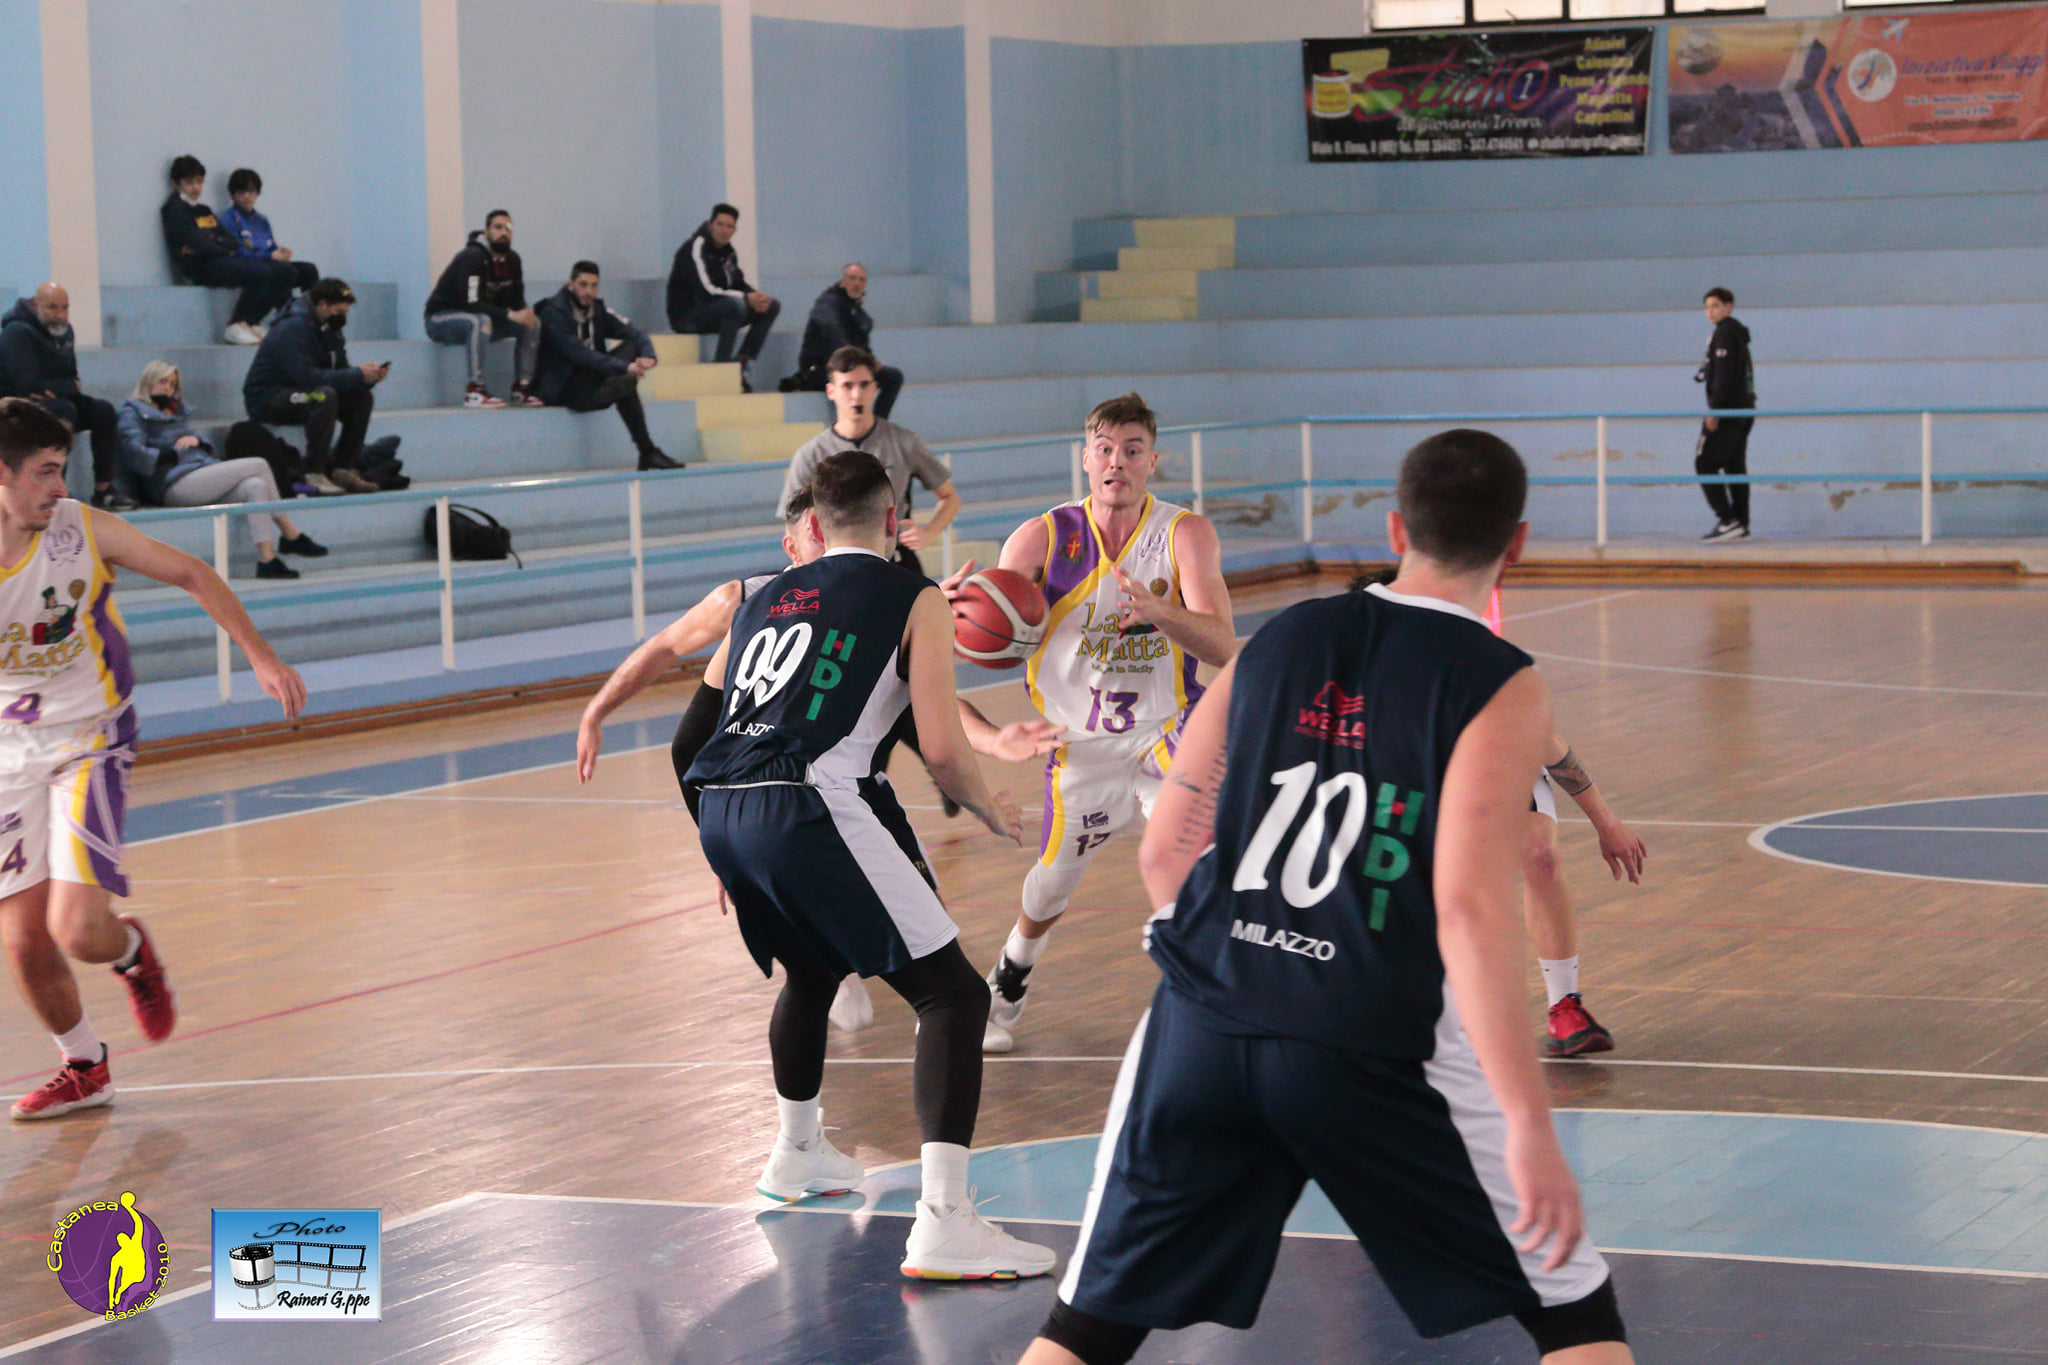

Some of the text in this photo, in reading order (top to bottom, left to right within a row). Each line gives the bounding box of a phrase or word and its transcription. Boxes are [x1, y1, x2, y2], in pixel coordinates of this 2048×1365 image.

[1520, 72, 1534, 99] 1
[770, 600, 820, 614] WELLA
[1081, 602, 1121, 634] La
[1075, 630, 1170, 665] Matta
[729, 622, 813, 716] 99
[1, 692, 42, 725] 4
[1085, 686, 1140, 734] 13
[1299, 708, 1366, 739] WELA
[1232, 761, 1367, 908] 10
[1, 837, 27, 875] 4
[1230, 919, 1336, 961] MILAZZO
